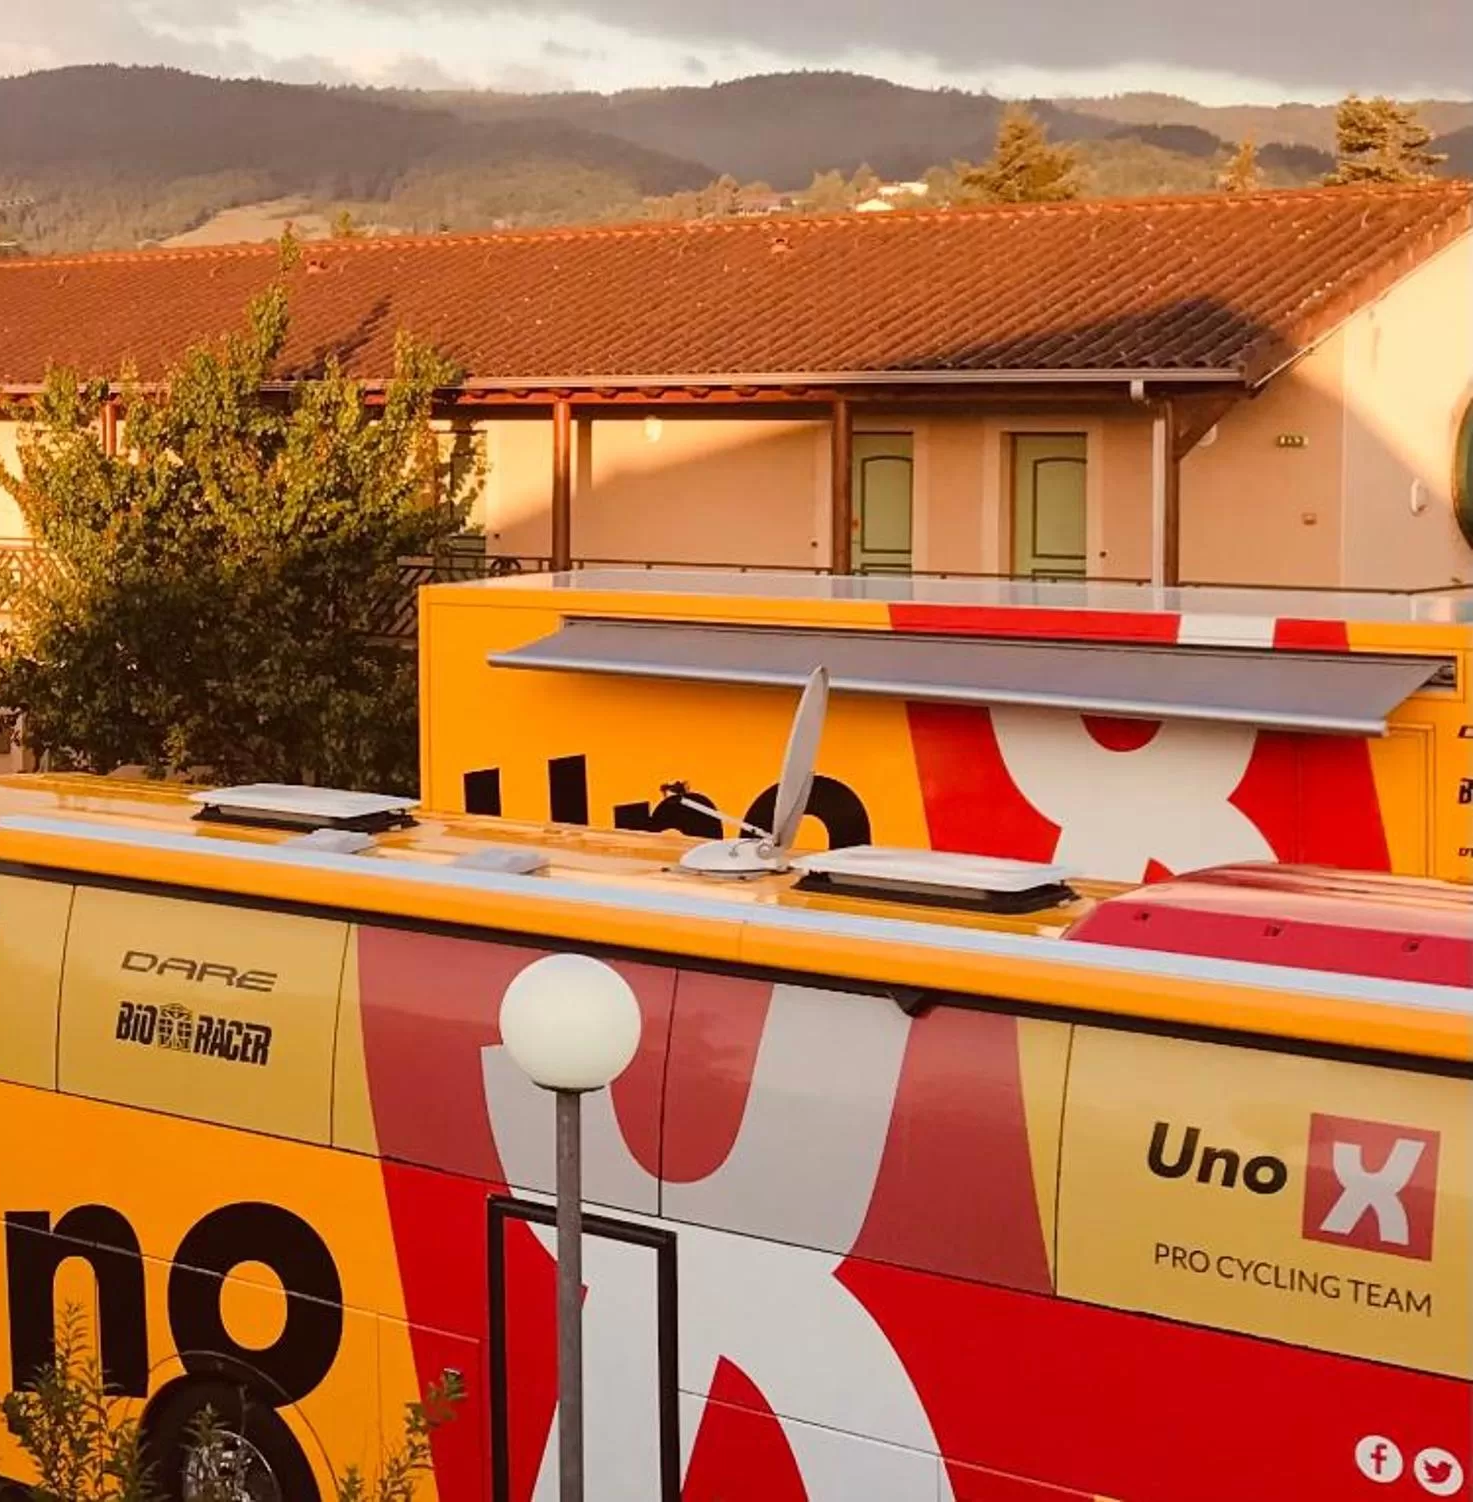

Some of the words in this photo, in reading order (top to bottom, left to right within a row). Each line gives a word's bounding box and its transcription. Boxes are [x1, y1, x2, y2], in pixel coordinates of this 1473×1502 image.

[121, 951, 278, 992] DARE
[1148, 1121, 1288, 1195] Uno
[1320, 1138, 1426, 1245] X
[1154, 1243, 1210, 1274] PRO
[1217, 1256, 1341, 1300] CYCLING
[1347, 1279, 1432, 1317] TEAM
